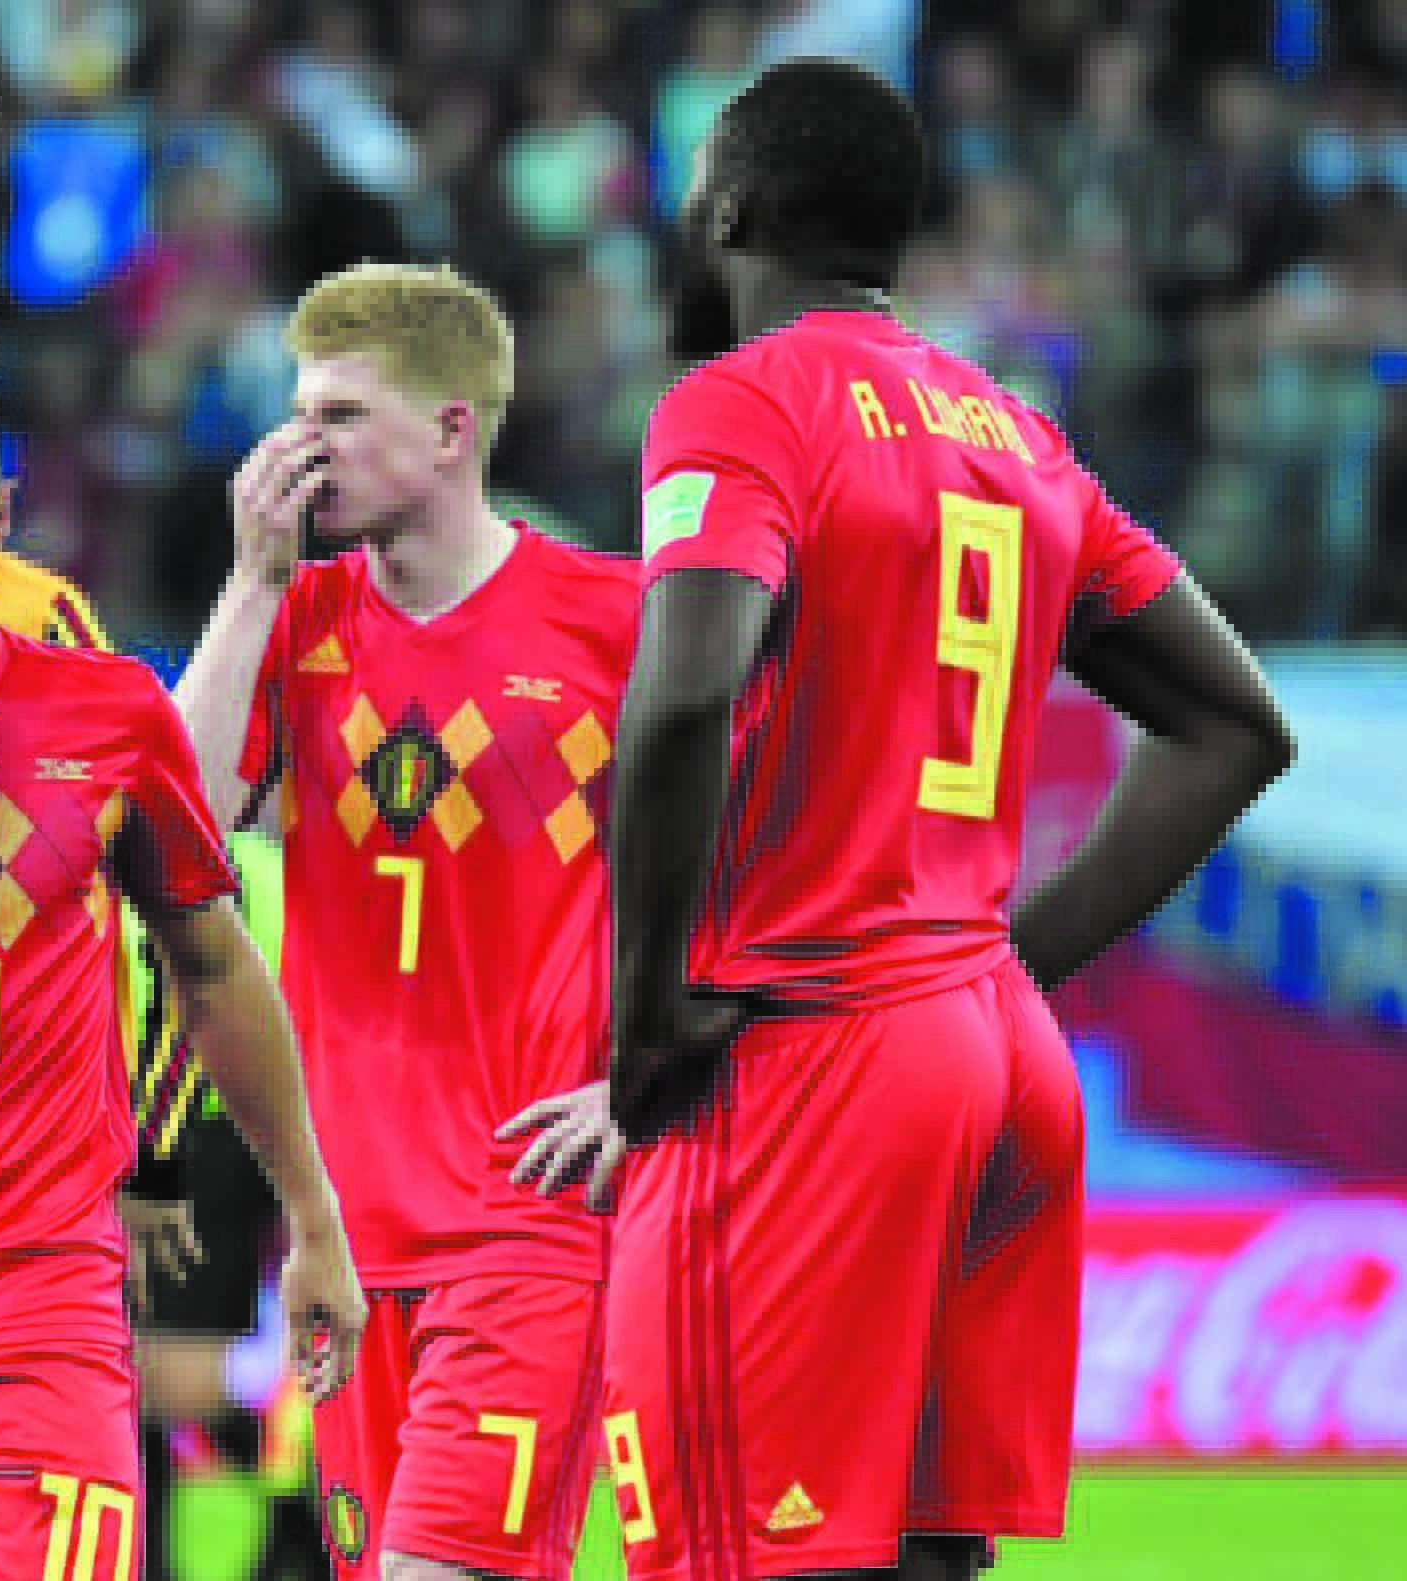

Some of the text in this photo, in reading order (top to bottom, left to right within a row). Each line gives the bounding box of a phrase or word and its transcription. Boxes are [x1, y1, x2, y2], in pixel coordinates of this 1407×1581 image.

[916, 489, 1024, 820] 9
[376, 856, 424, 973] 7
[40, 1472, 135, 1581] 10
[478, 1413, 537, 1534] 7
